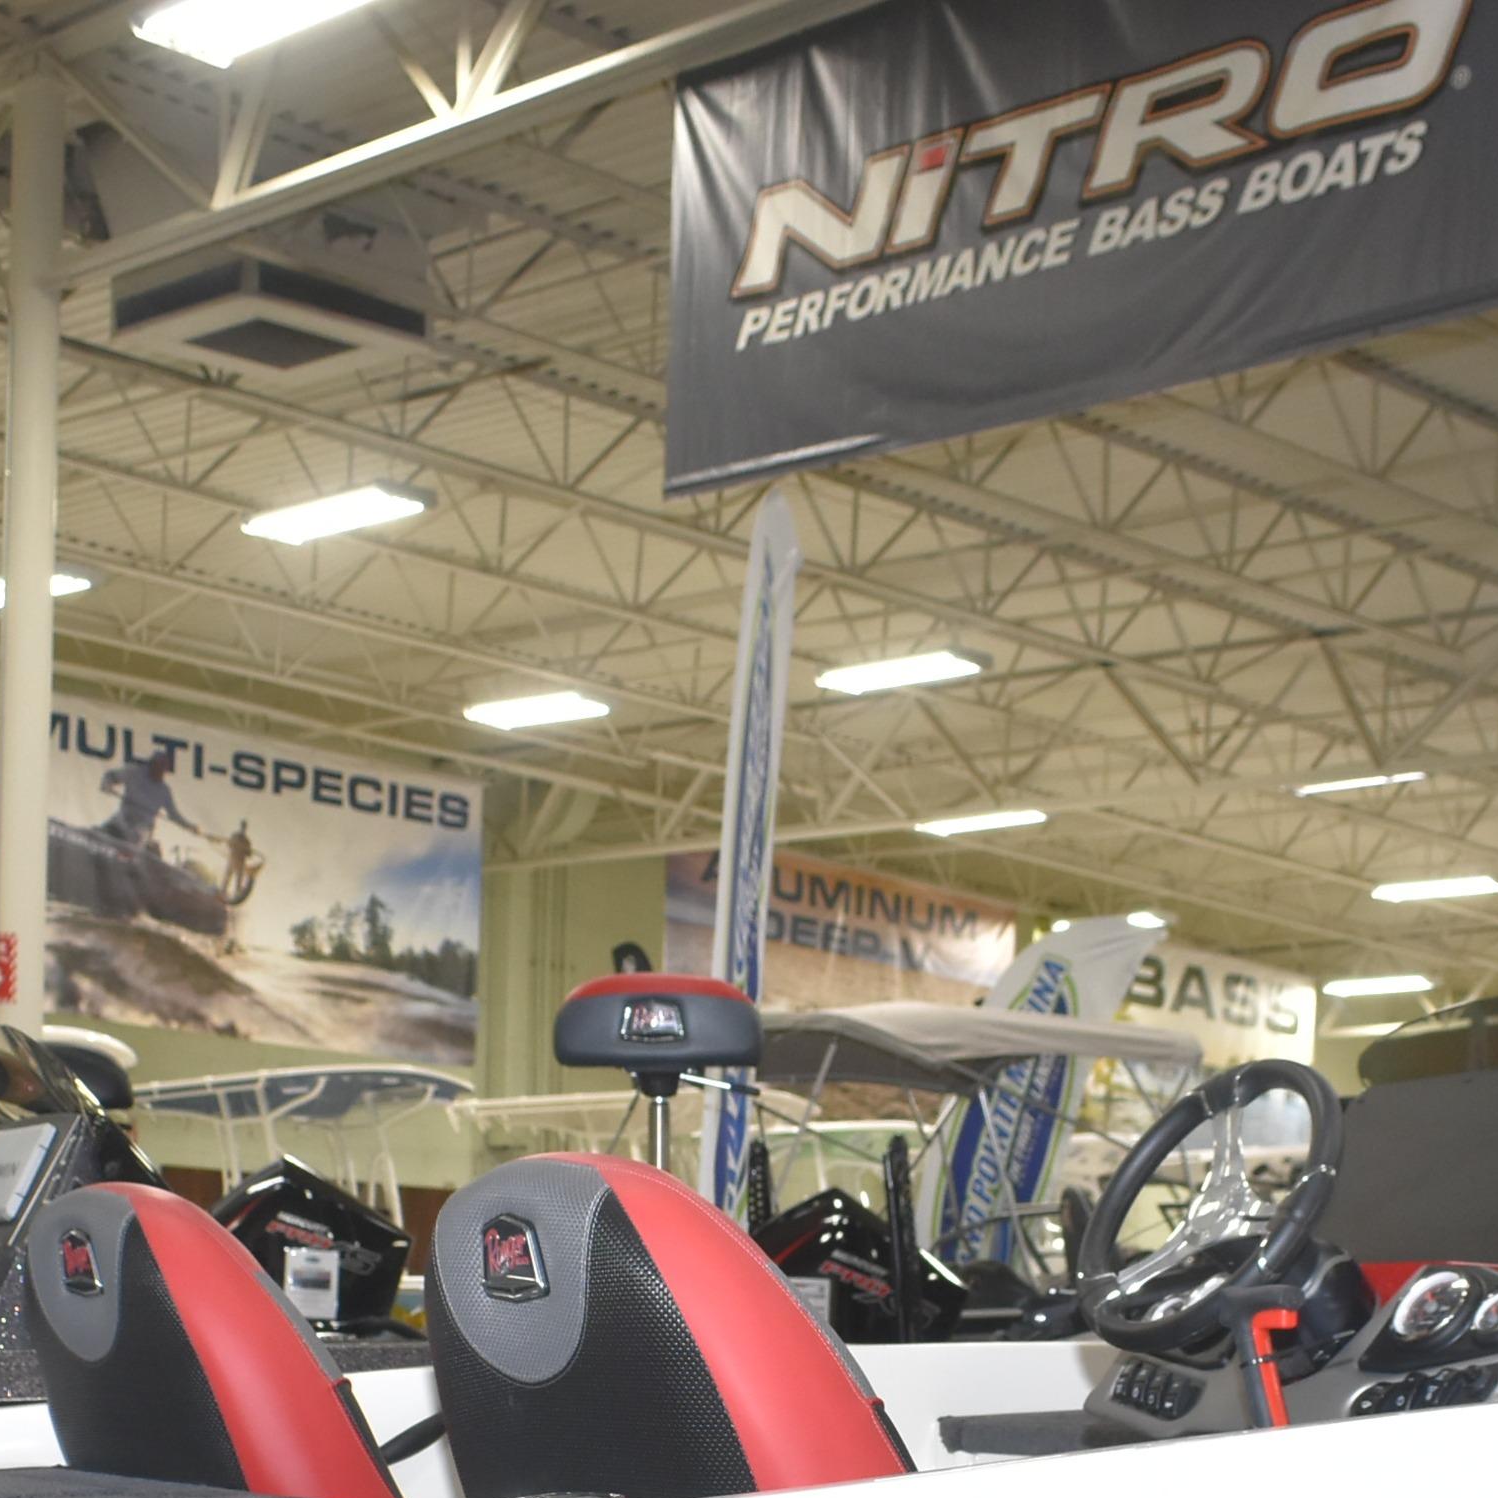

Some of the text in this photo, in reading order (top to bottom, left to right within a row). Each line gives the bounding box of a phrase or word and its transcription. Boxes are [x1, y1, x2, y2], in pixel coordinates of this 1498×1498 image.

[735, 120, 1428, 351] PERFORMANCE BASS BOATS
[702, 849, 978, 941] AUMINUM
[1128, 954, 1299, 1035] BASS
